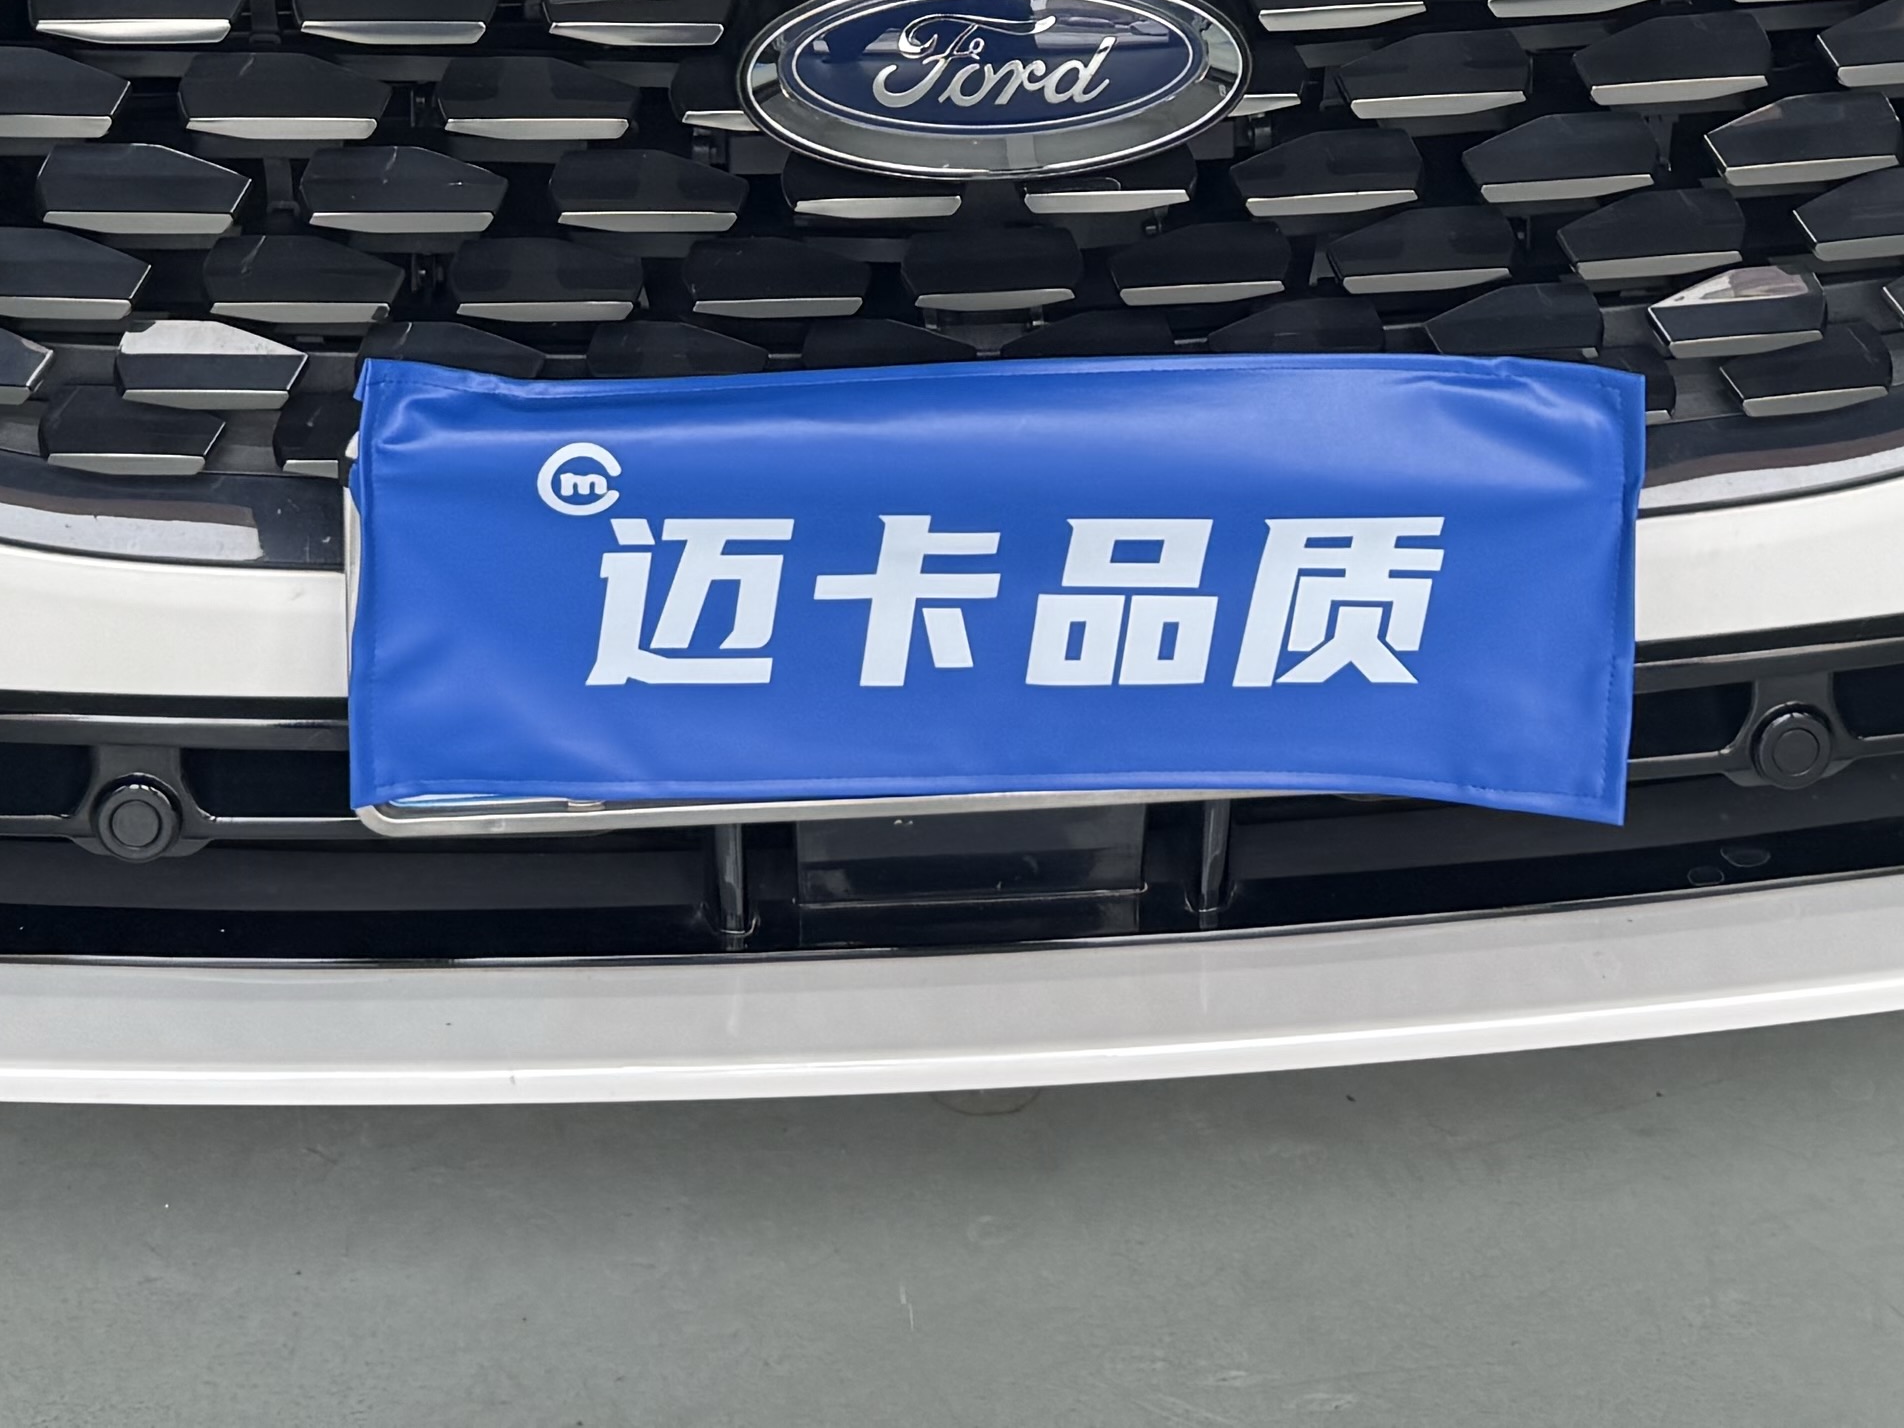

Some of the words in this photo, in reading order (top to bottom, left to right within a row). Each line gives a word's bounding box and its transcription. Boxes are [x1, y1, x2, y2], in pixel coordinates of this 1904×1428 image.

[872, 13, 1116, 108] Ford
[585, 515, 1445, 688] 迈卡品质
